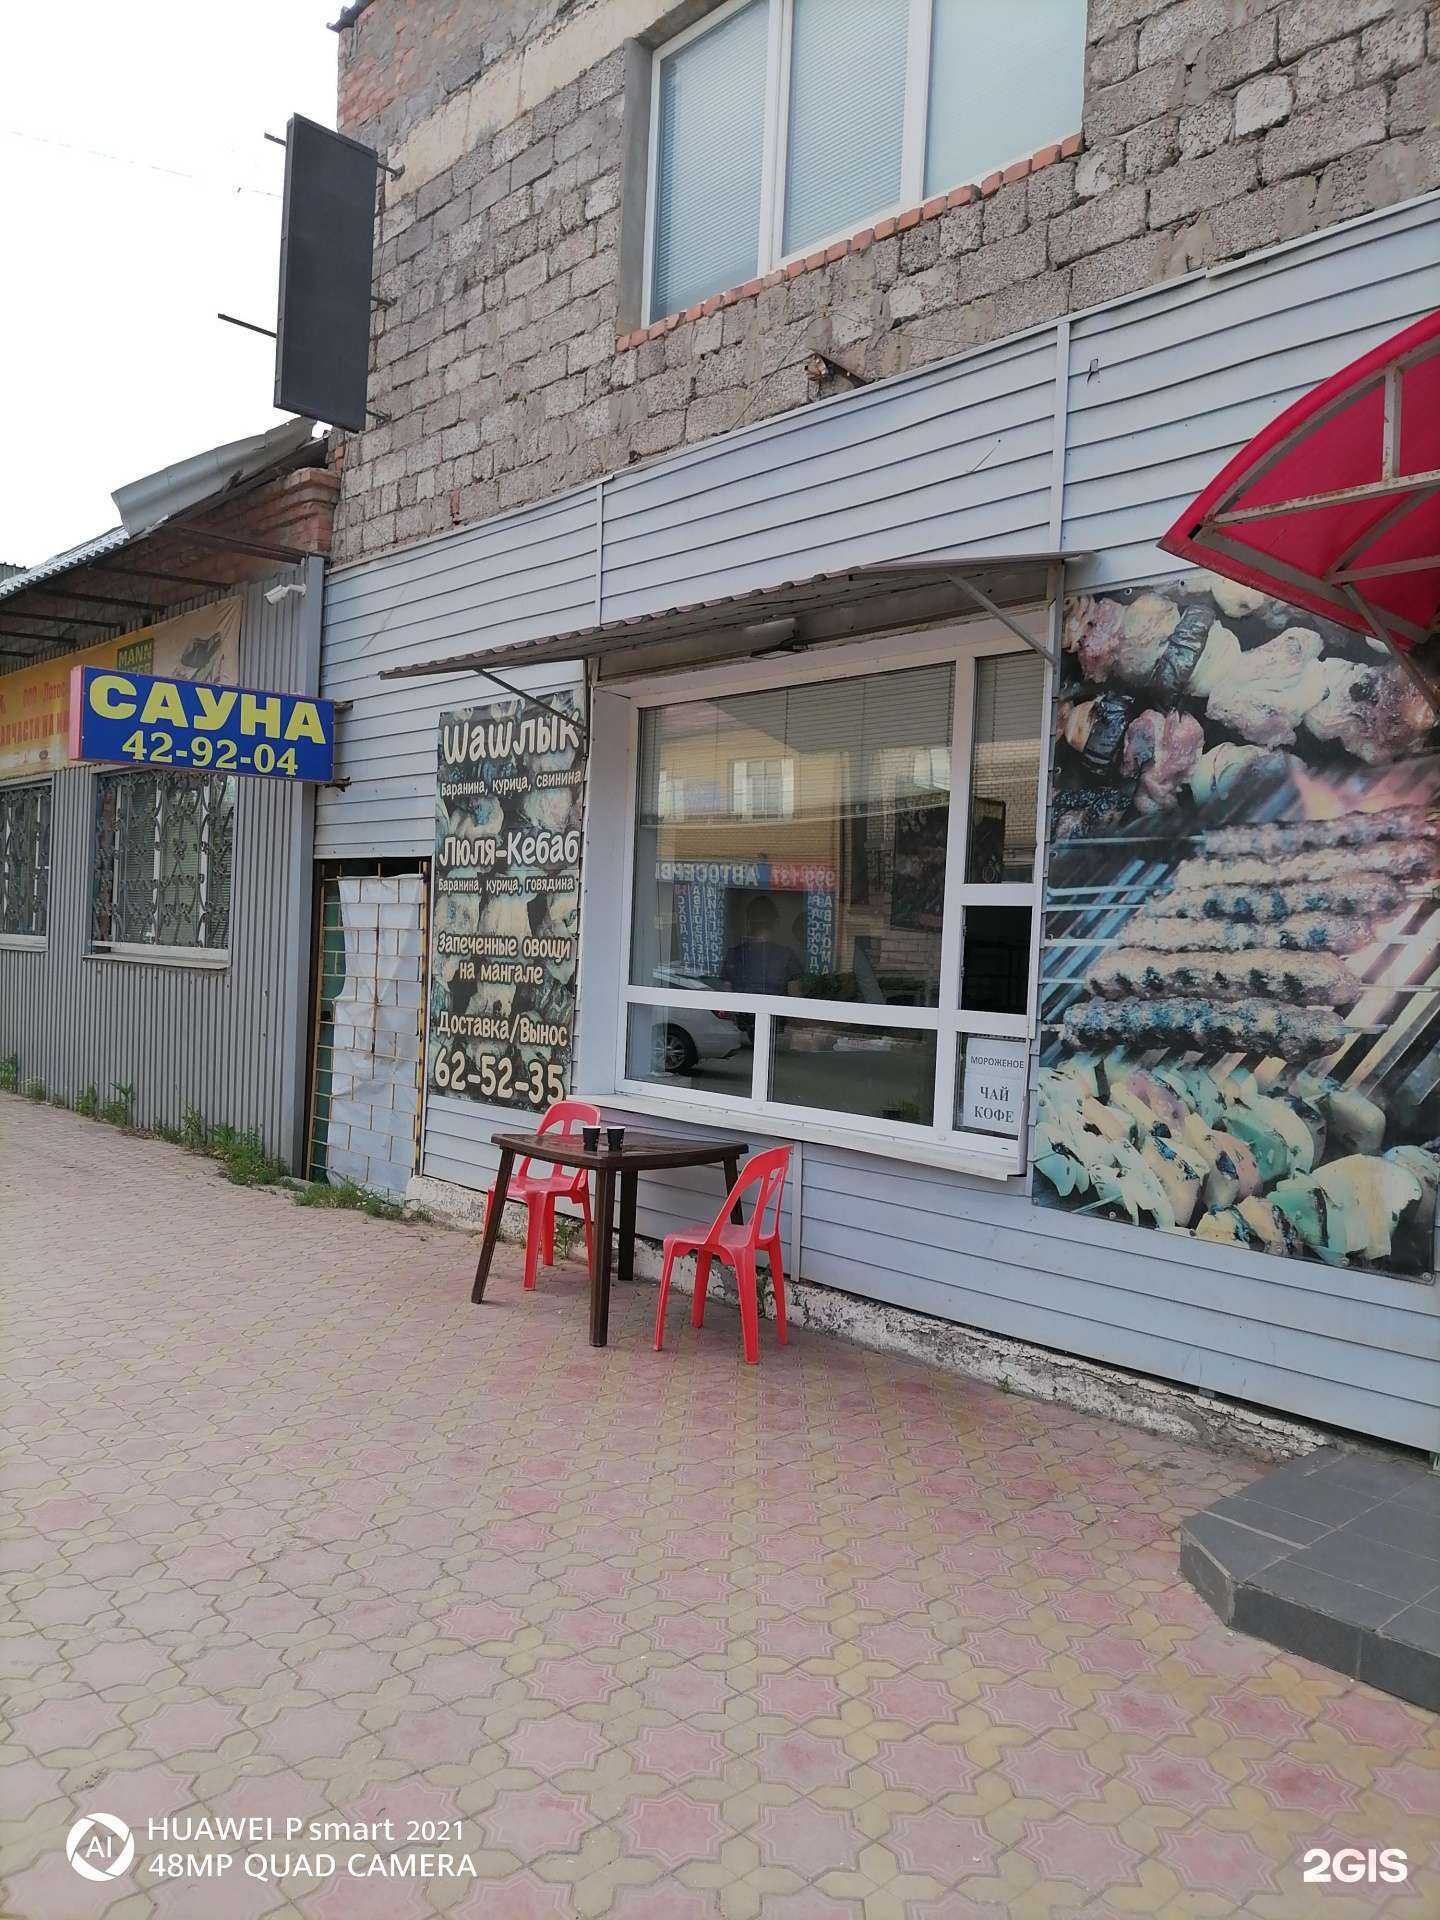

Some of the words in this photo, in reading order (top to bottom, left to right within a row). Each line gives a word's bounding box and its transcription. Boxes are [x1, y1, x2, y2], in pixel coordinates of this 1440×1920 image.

[89, 675, 326, 745] САУНА
[122, 730, 298, 776] 42-92-04
[492, 775, 532, 795] курица,
[536, 770, 582, 788] свинина
[439, 831, 580, 867] Люля-Кебаб
[486, 878, 522, 895] курица,
[525, 876, 573, 891] говядина
[523, 938, 571, 963] овощи
[459, 962, 476, 980] на
[481, 963, 544, 985] мангале
[437, 1011, 568, 1047] Доставка/Вынос
[970, 1055, 1025, 1069] МОРОЖЕНОЕ
[434, 1048, 564, 1104] 62-52-35
[980, 1086, 1009, 1101] ЧАЙ
[974, 1105, 1014, 1123] КОФЕ
